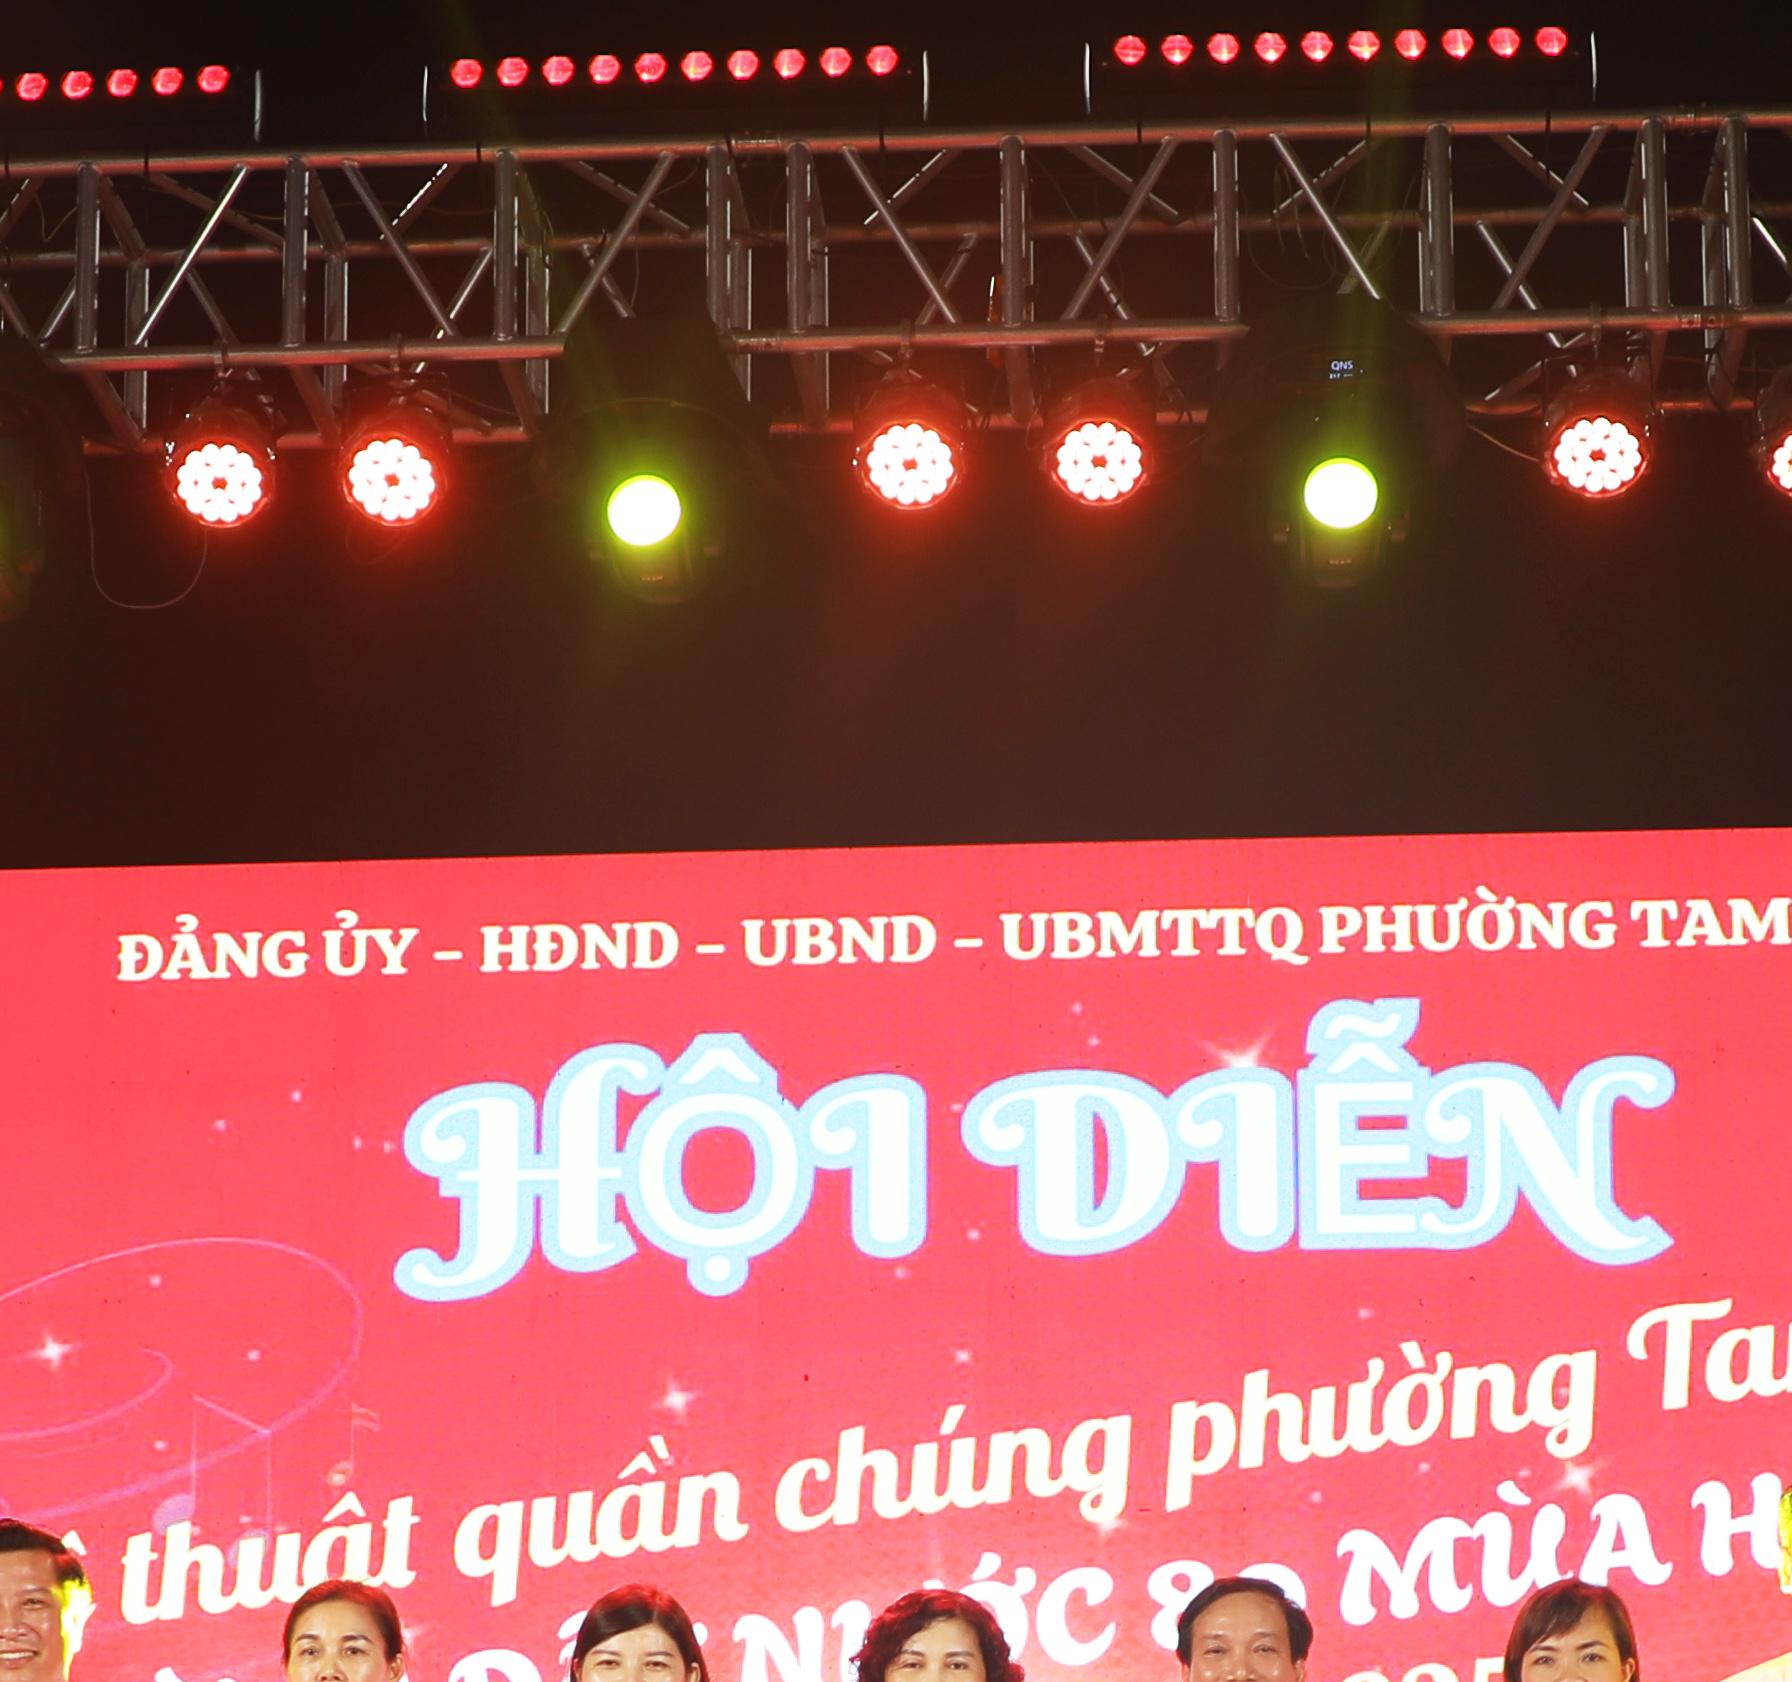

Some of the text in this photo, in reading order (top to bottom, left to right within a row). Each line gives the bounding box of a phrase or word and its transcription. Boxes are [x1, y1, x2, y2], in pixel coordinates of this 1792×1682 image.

[1330, 360, 1354, 370] QNS
[116, 913, 310, 981] ĐẢNG
[321, 909, 419, 976] ỦY
[479, 921, 679, 973] HĐND
[741, 914, 938, 968] UBND
[1000, 904, 1310, 967] UBMTTQ
[1319, 885, 1619, 955] PHƯỜNG
[1631, 896, 1792, 949] TAM
[394, 996, 1675, 1302] HỘI DIỄN
[453, 1435, 750, 1607] quần
[775, 1404, 1132, 1524] chúng
[1165, 1341, 1598, 1513] phường
[1336, 1480, 1674, 1627] MÙA
